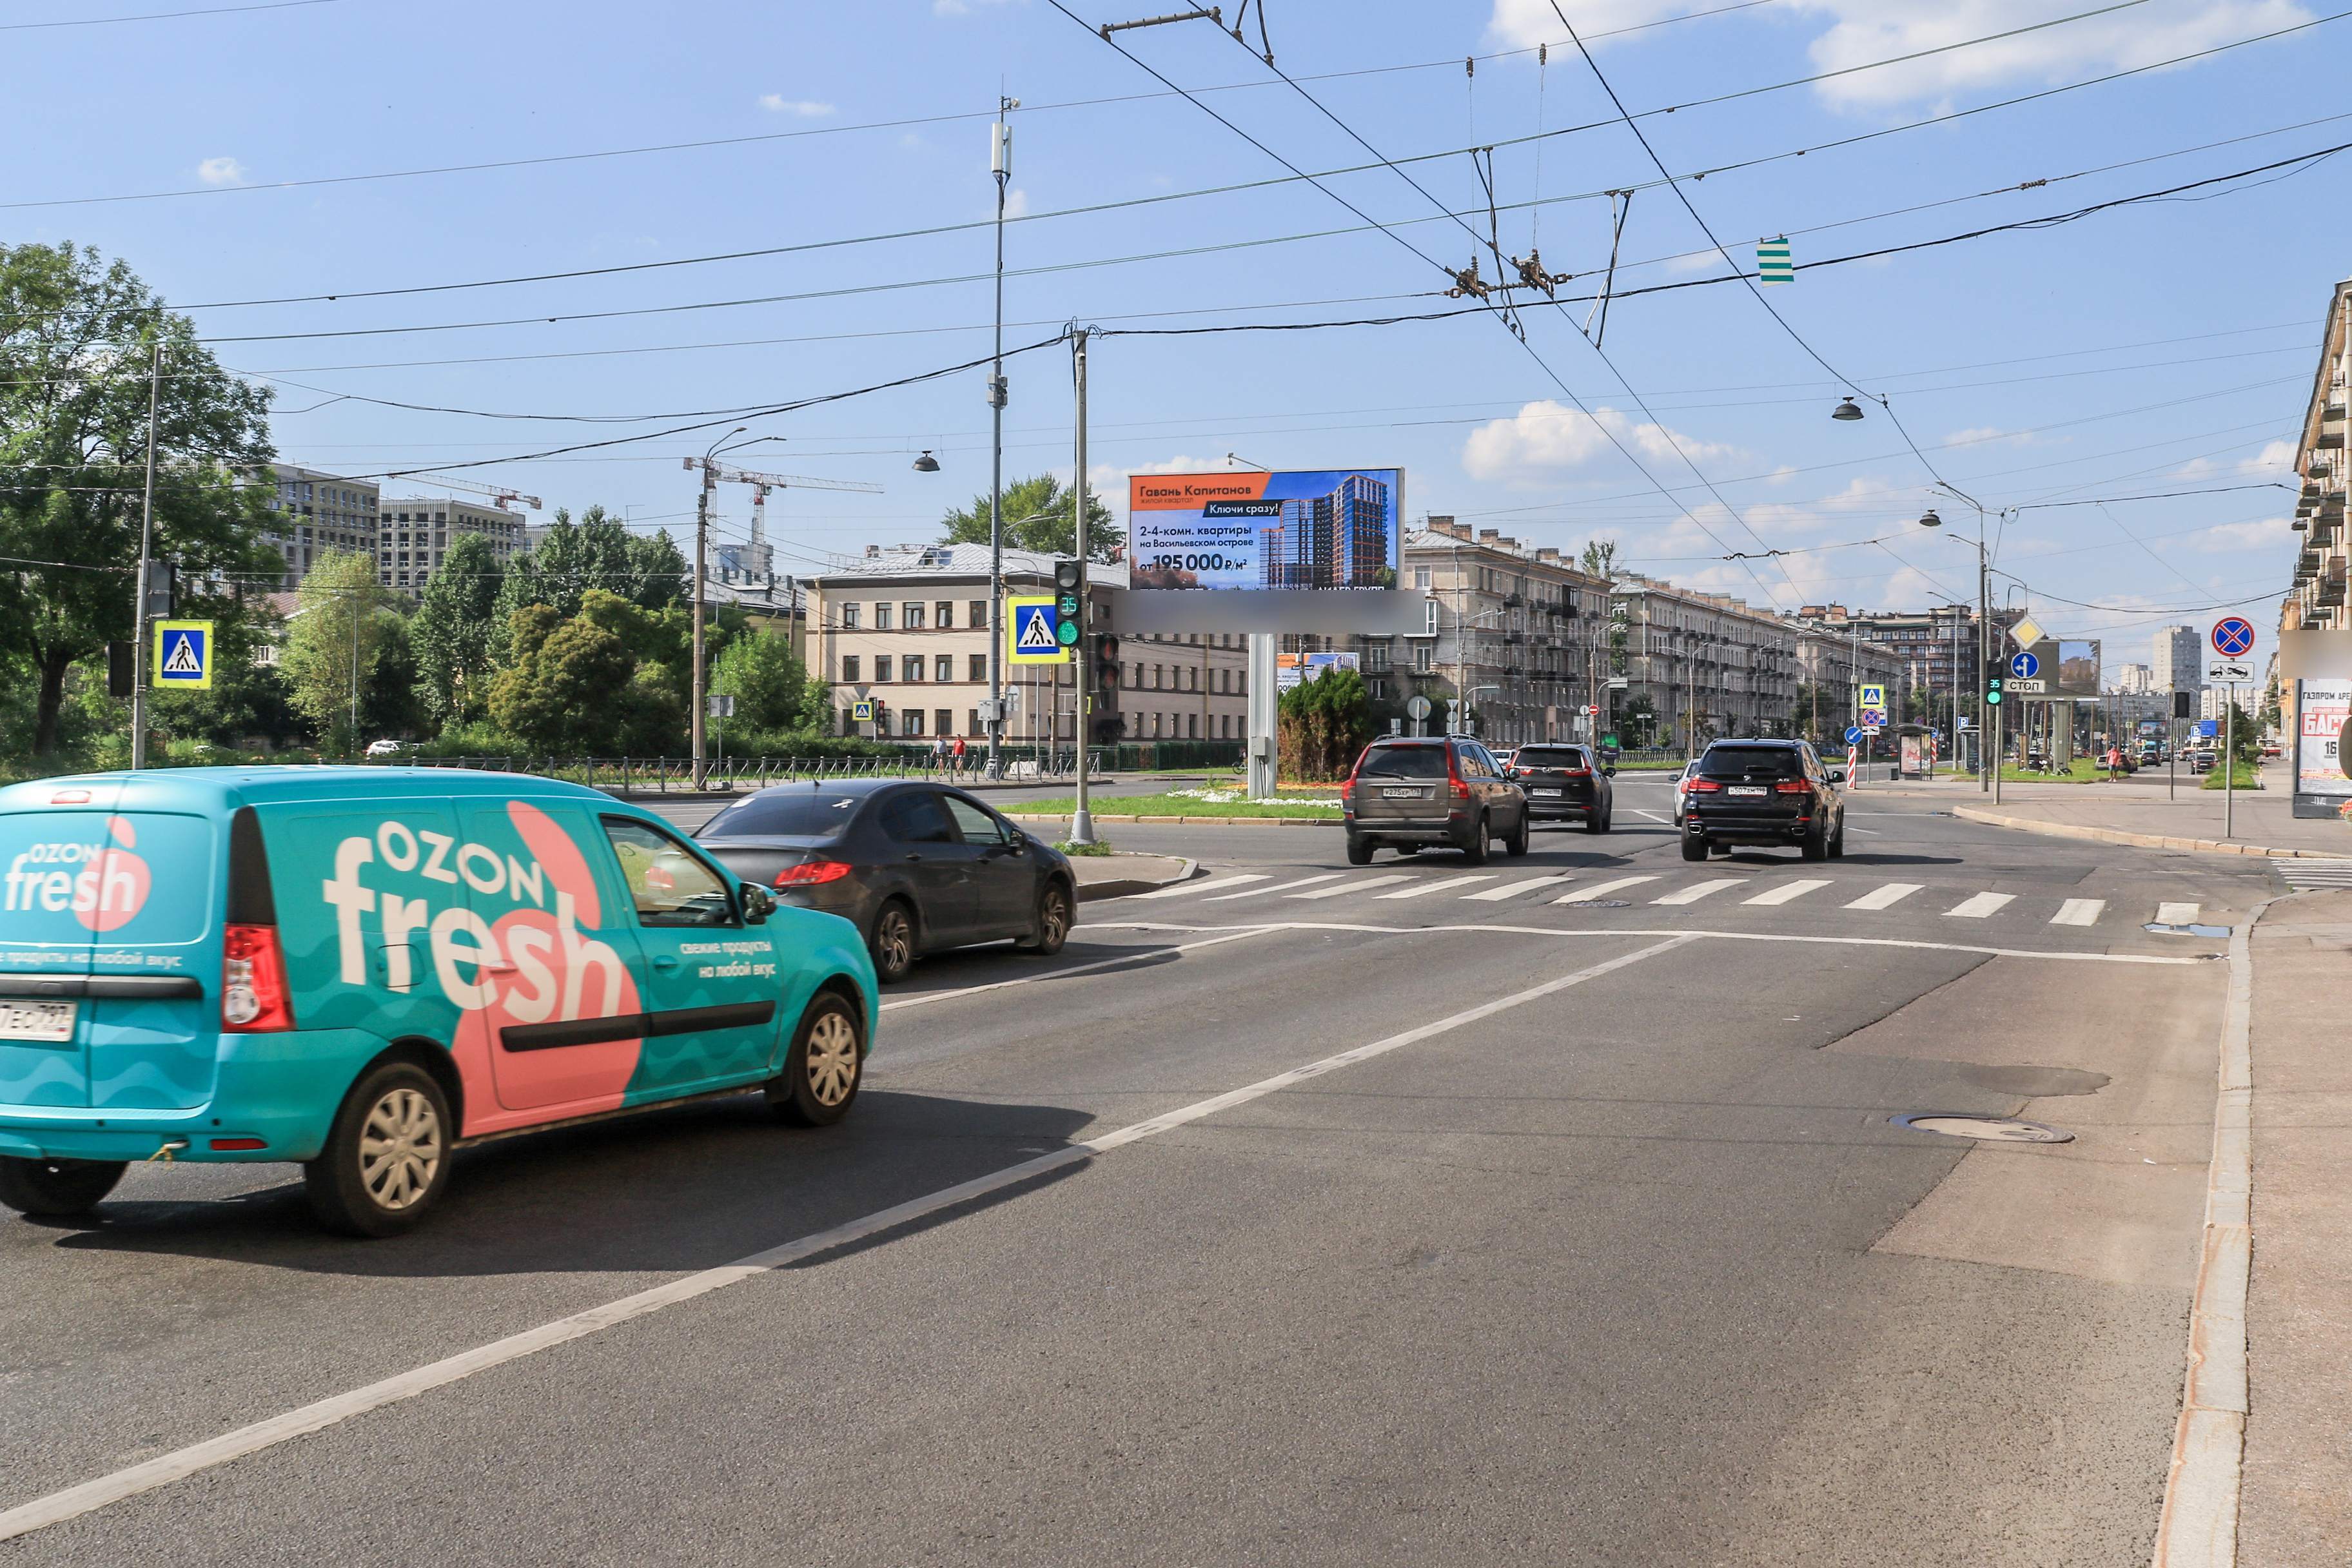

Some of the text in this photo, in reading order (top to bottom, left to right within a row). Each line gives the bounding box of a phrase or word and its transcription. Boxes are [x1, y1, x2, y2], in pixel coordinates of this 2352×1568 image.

[1140, 485, 1251, 496] Гавань Капитанов
[1210, 503, 1279, 515] Ключи сразу!
[1140, 526, 1252, 538] 2-4-комн. квартиры
[1153, 539, 1216, 547] Васильевском
[1218, 539, 1253, 548] острове
[1186, 554, 1223, 571] 000
[1062, 597, 1076, 612] 35
[1990, 679, 2000, 688] 35
[2010, 681, 2039, 691] СТОП
[2325, 741, 2337, 754] 16
[30, 843, 103, 863] OZON
[377, 821, 544, 908] OZON
[5, 852, 135, 912] fresh
[323, 836, 623, 1023] fresh
[680, 941, 772, 956] свежие продукты
[6, 952, 68, 966] продукты
[92, 950, 143, 965] любой
[146, 955, 182, 970] вкус
[698, 960, 776, 979] на любой вкус
